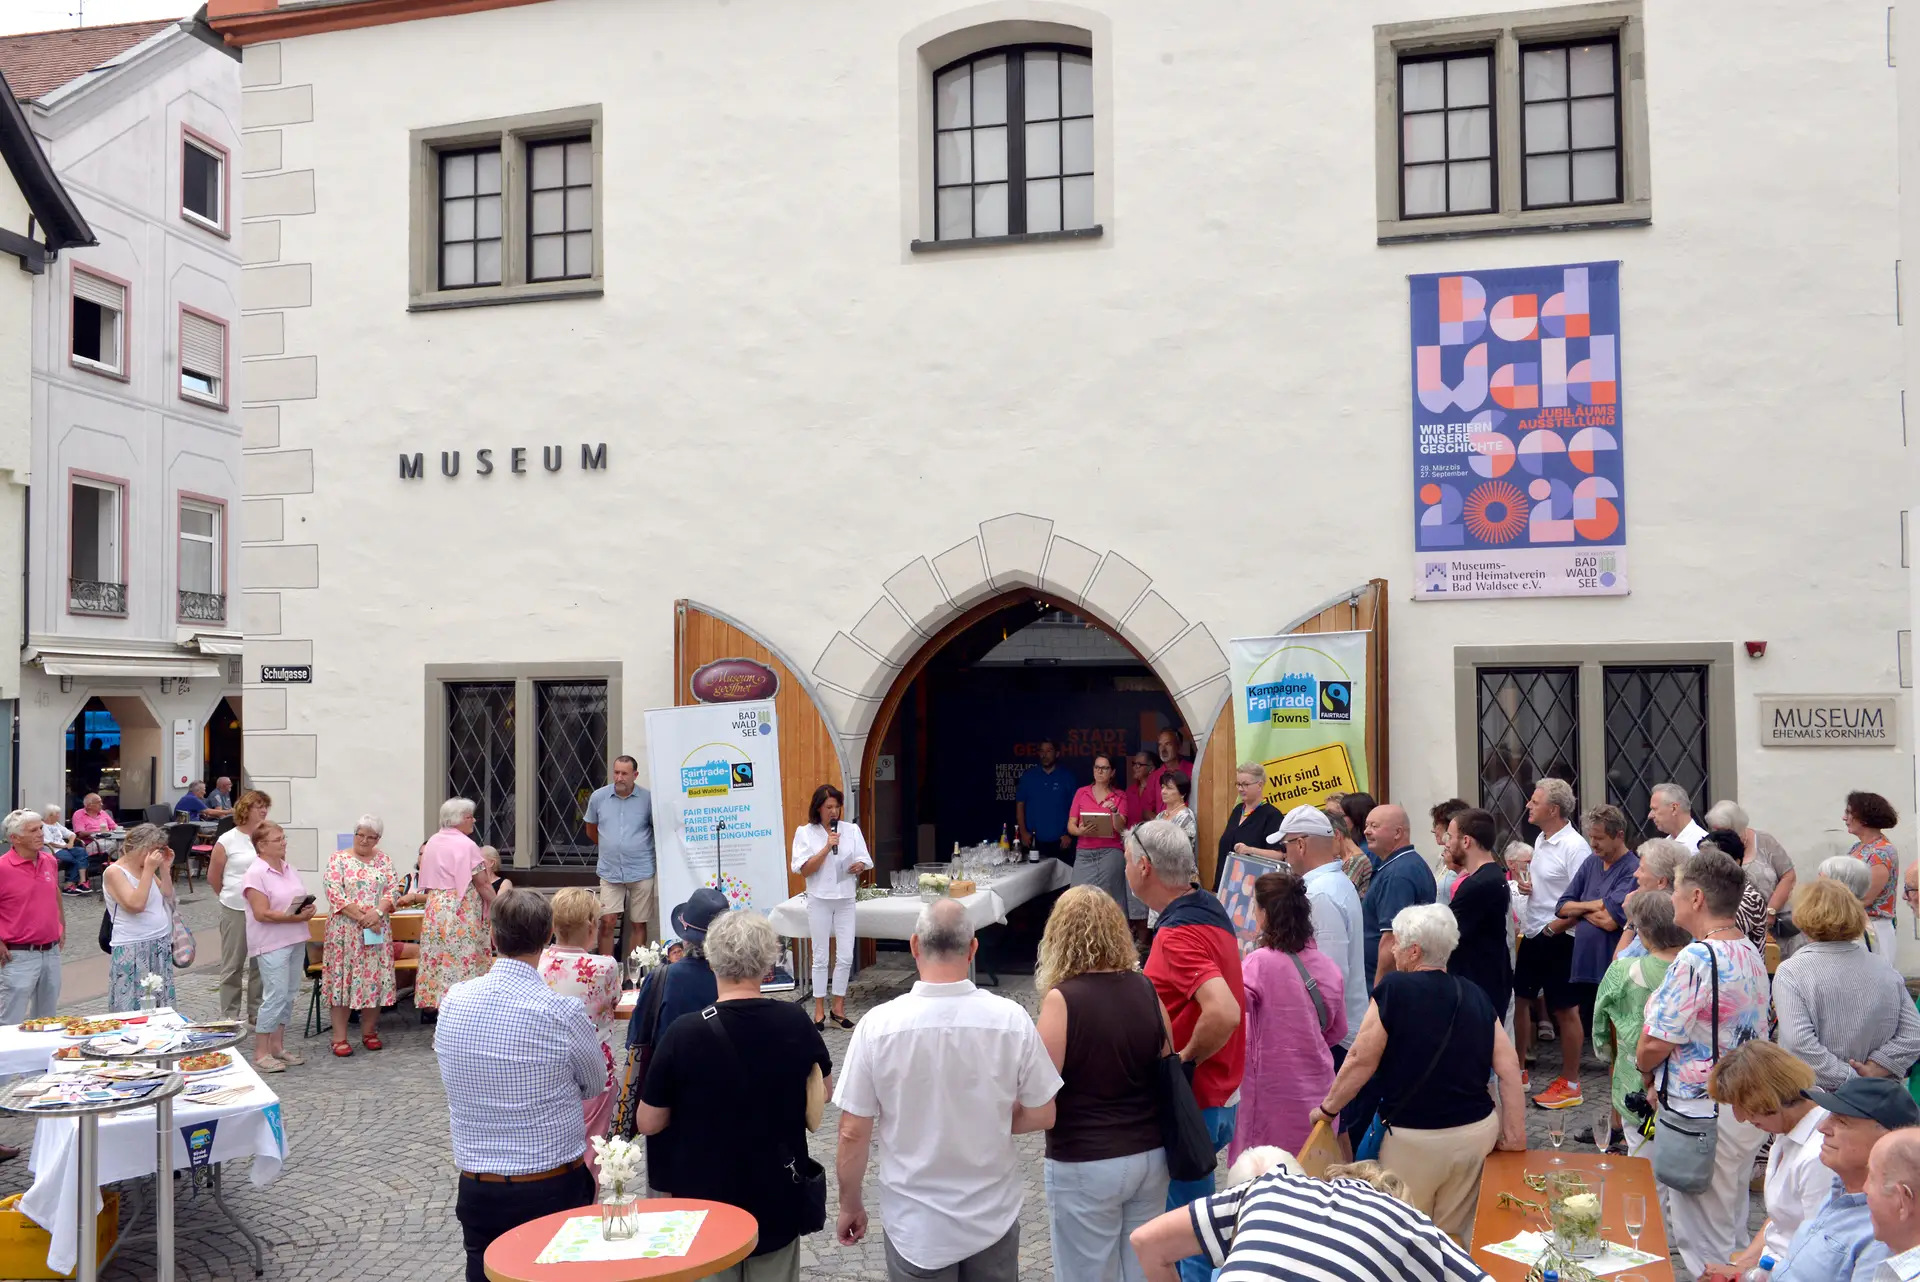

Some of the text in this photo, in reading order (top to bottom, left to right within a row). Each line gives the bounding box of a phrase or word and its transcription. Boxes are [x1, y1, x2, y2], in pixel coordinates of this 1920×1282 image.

[1537, 404, 1616, 419] JUBILÄUMS
[1419, 421, 1492, 435] WIR FEIERN
[1518, 415, 1616, 430] AUSSTELLUNG
[1419, 432, 1470, 444] UNSERE
[1419, 440, 1504, 454] GESCHICHTE
[399, 443, 608, 479] MUSEUM
[1432, 464, 1449, 472] März
[1432, 469, 1469, 478] September
[1419, 475, 1620, 546] 2025
[1451, 562, 1506, 571] Museums-
[1575, 557, 1597, 567] BAD
[1452, 570, 1546, 582] und Heimatverein
[1566, 568, 1598, 578] WALD
[1452, 580, 1542, 592] Bad Waldsee e.V.
[1578, 578, 1598, 589] SEE
[263, 667, 308, 682] Schulgasse
[708, 669, 765, 686] Museum
[712, 681, 752, 699] geöffnet
[1248, 684, 1307, 697] Kampagne
[1249, 692, 1315, 711] Fairtrade
[738, 712, 756, 721] BAD
[1272, 711, 1310, 724] Towns
[1774, 708, 1884, 729] MUSEUM
[731, 721, 757, 730] WALD
[742, 729, 758, 738] SEE
[1068, 728, 1128, 743] STADT
[1772, 729, 1886, 739] EHEMALS KORNHAUS
[1012, 742, 1128, 757] GEHICHTE
[682, 767, 729, 778] Fairtrade-
[1270, 765, 1320, 788] Wir sind
[682, 776, 709, 787] Stadt
[689, 788, 701, 796] Bad
[1264, 775, 1343, 804] airtrade-Stadt
[683, 805, 751, 817] FAIR EINKAUFEN
[684, 815, 738, 825] FAIRER LOHN
[685, 825, 708, 834] FAIRE
[686, 834, 709, 843] FAIRE
